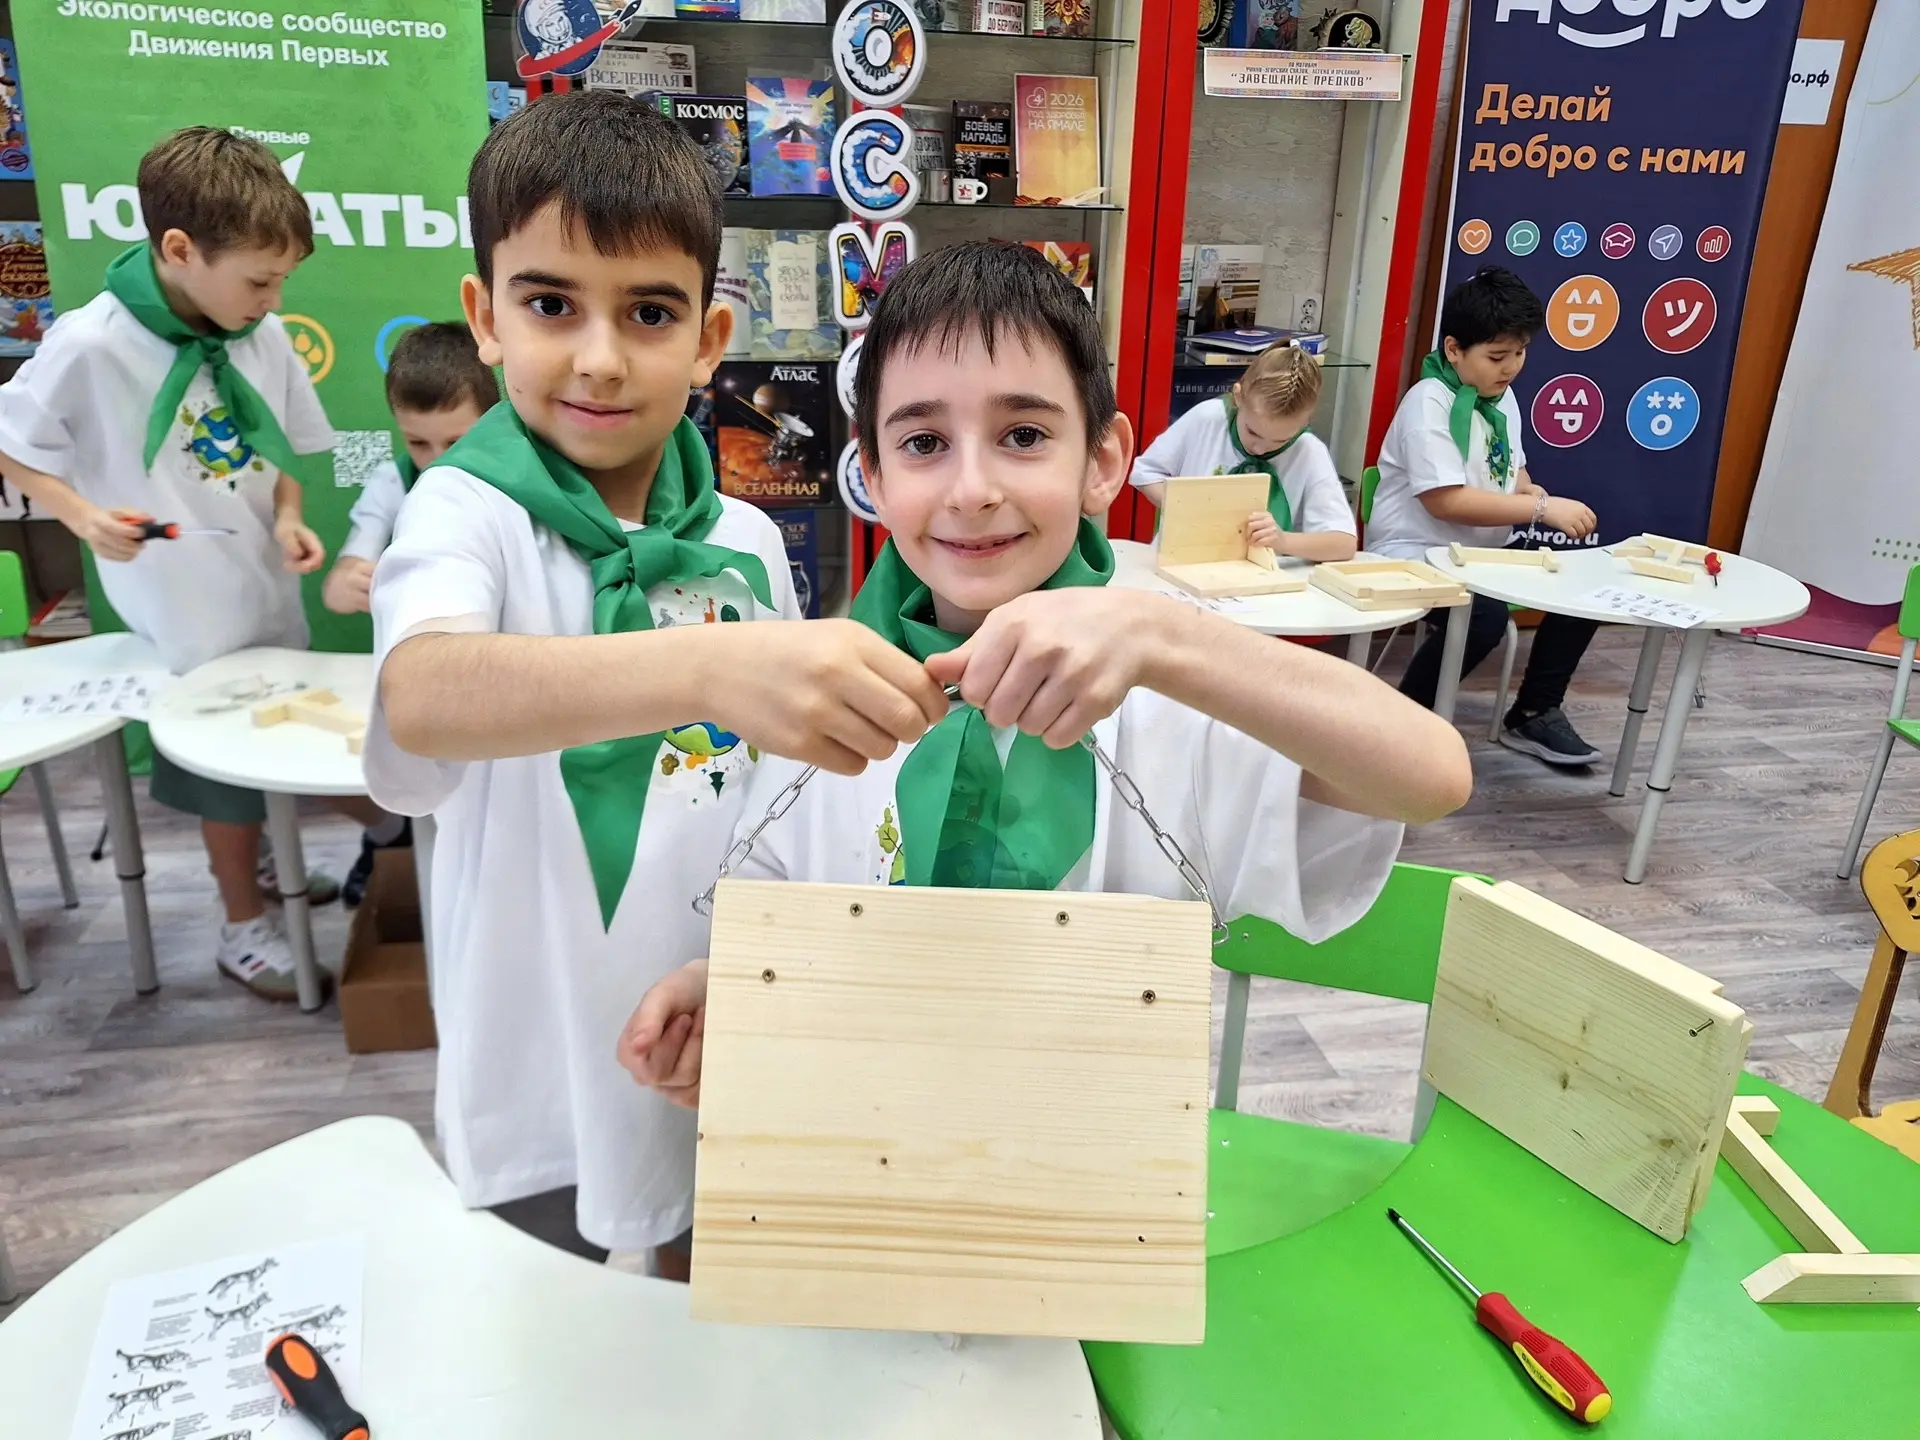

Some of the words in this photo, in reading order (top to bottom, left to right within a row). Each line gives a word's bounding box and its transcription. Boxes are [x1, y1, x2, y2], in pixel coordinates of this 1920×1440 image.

[57, 0, 274, 29] Экологическое
[281, 11, 447, 39] сообщество
[128, 29, 274, 60] Движения
[281, 39, 390, 68] Первых
[590, 69, 680, 88] ВСЕЛЕННАЯ
[1050, 93, 1084, 106] 2026
[1475, 83, 1611, 125] Делай
[676, 104, 745, 120] КОСМОС
[965, 121, 1004, 133] БОЕВЫЕ
[1028, 119, 1044, 130] НА
[1047, 119, 1085, 132] ЯМАЛЕ
[961, 132, 1006, 144] НАГРАДЫ
[1468, 133, 1597, 178] добро
[1607, 146, 1631, 172] с
[1640, 147, 1746, 175] нами
[770, 366, 818, 382] Атлас
[733, 482, 819, 496] ВСЕЛЕННАЯ
